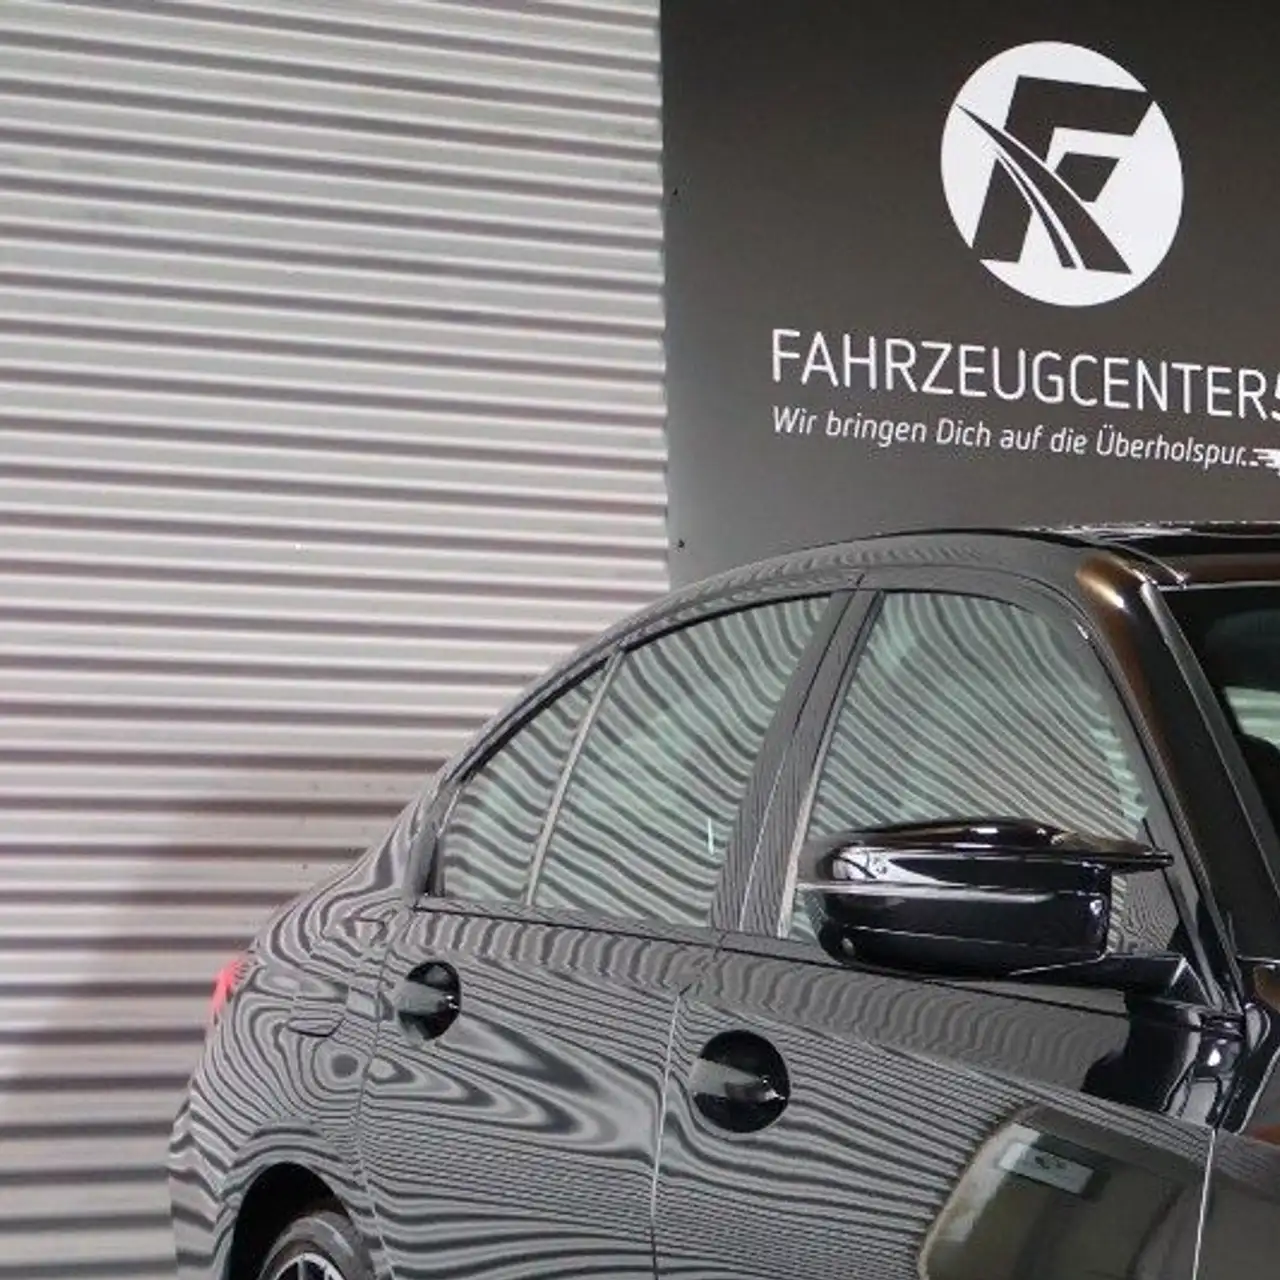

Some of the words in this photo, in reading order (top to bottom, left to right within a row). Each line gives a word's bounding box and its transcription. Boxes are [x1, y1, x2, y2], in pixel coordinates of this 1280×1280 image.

[771, 404, 818, 435] Wir
[825, 409, 927, 448] bringen
[936, 417, 992, 448] Dich
[1000, 424, 1044, 451] auf
[1050, 427, 1088, 455] die
